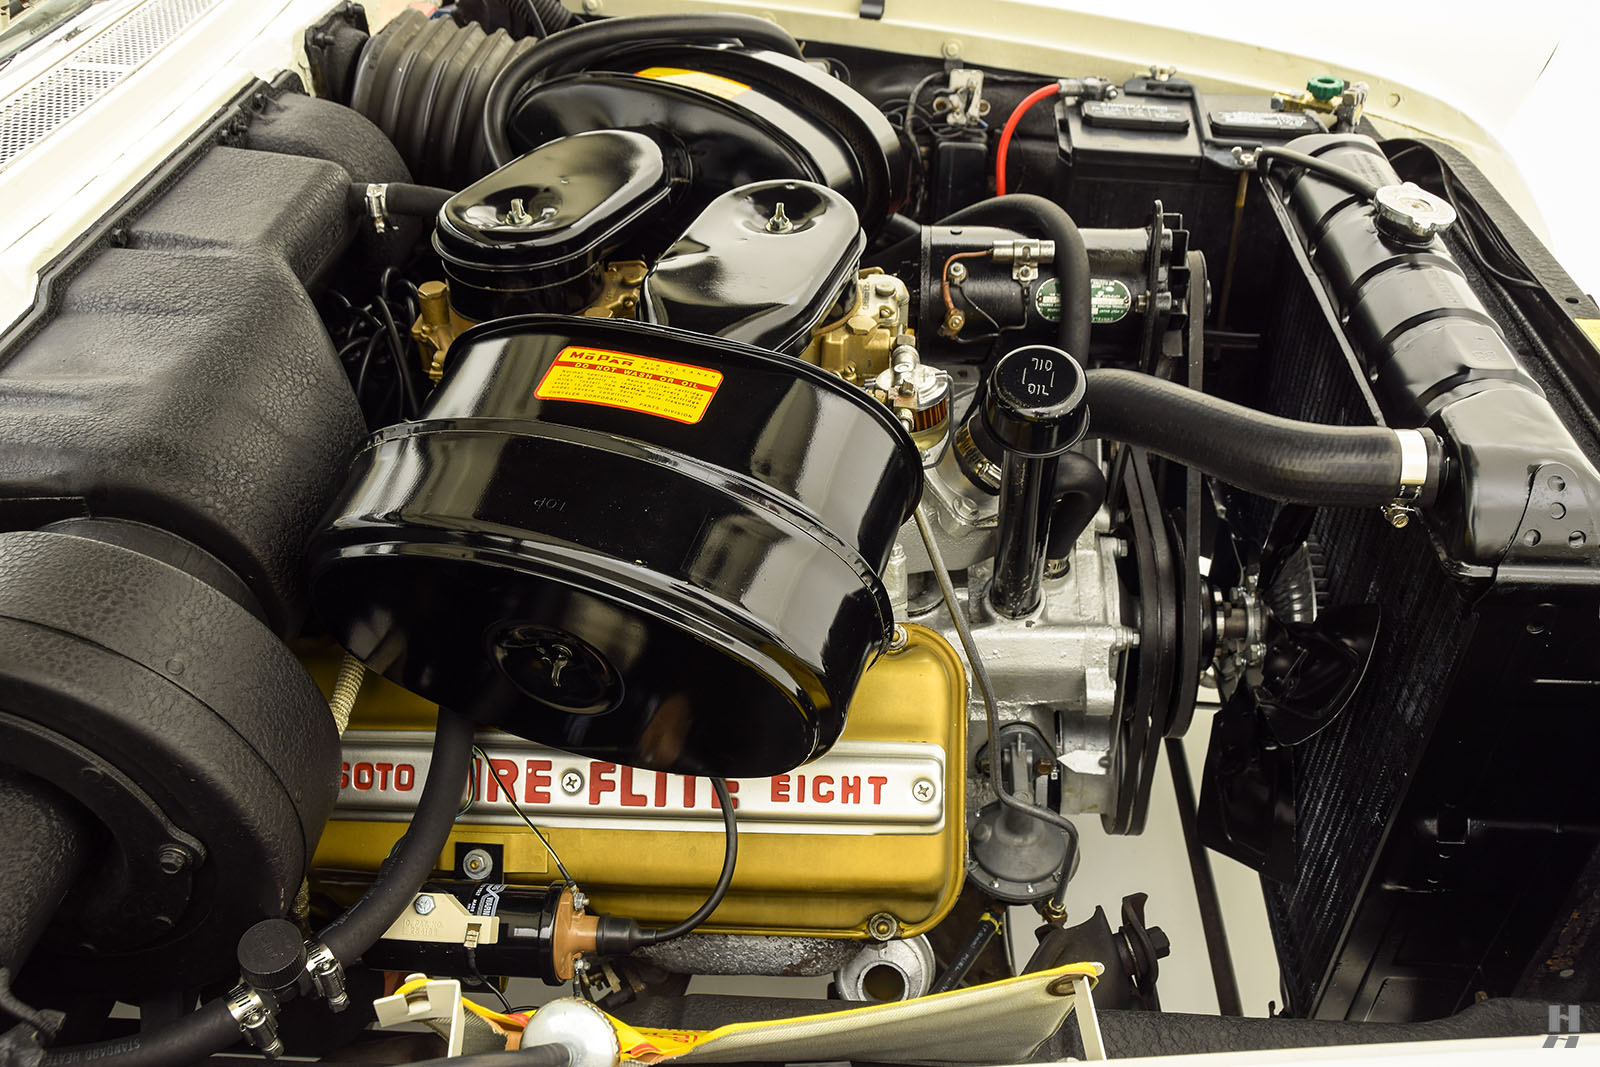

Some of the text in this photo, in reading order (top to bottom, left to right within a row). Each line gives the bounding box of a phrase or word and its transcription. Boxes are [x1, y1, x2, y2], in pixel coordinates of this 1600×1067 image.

[594, 365, 617, 373] NOT
[622, 369, 653, 379] WASH
[680, 380, 699, 388] OIL
[1027, 383, 1049, 395] OIL
[584, 393, 630, 404] CORPORATION
[662, 408, 694, 418] DIVISION
[468, 759, 552, 804] IRE
[770, 774, 888, 804] EIGHT
[482, 897, 494, 916] WARN
[45, 1038, 140, 1066] STANDARD HEATE
